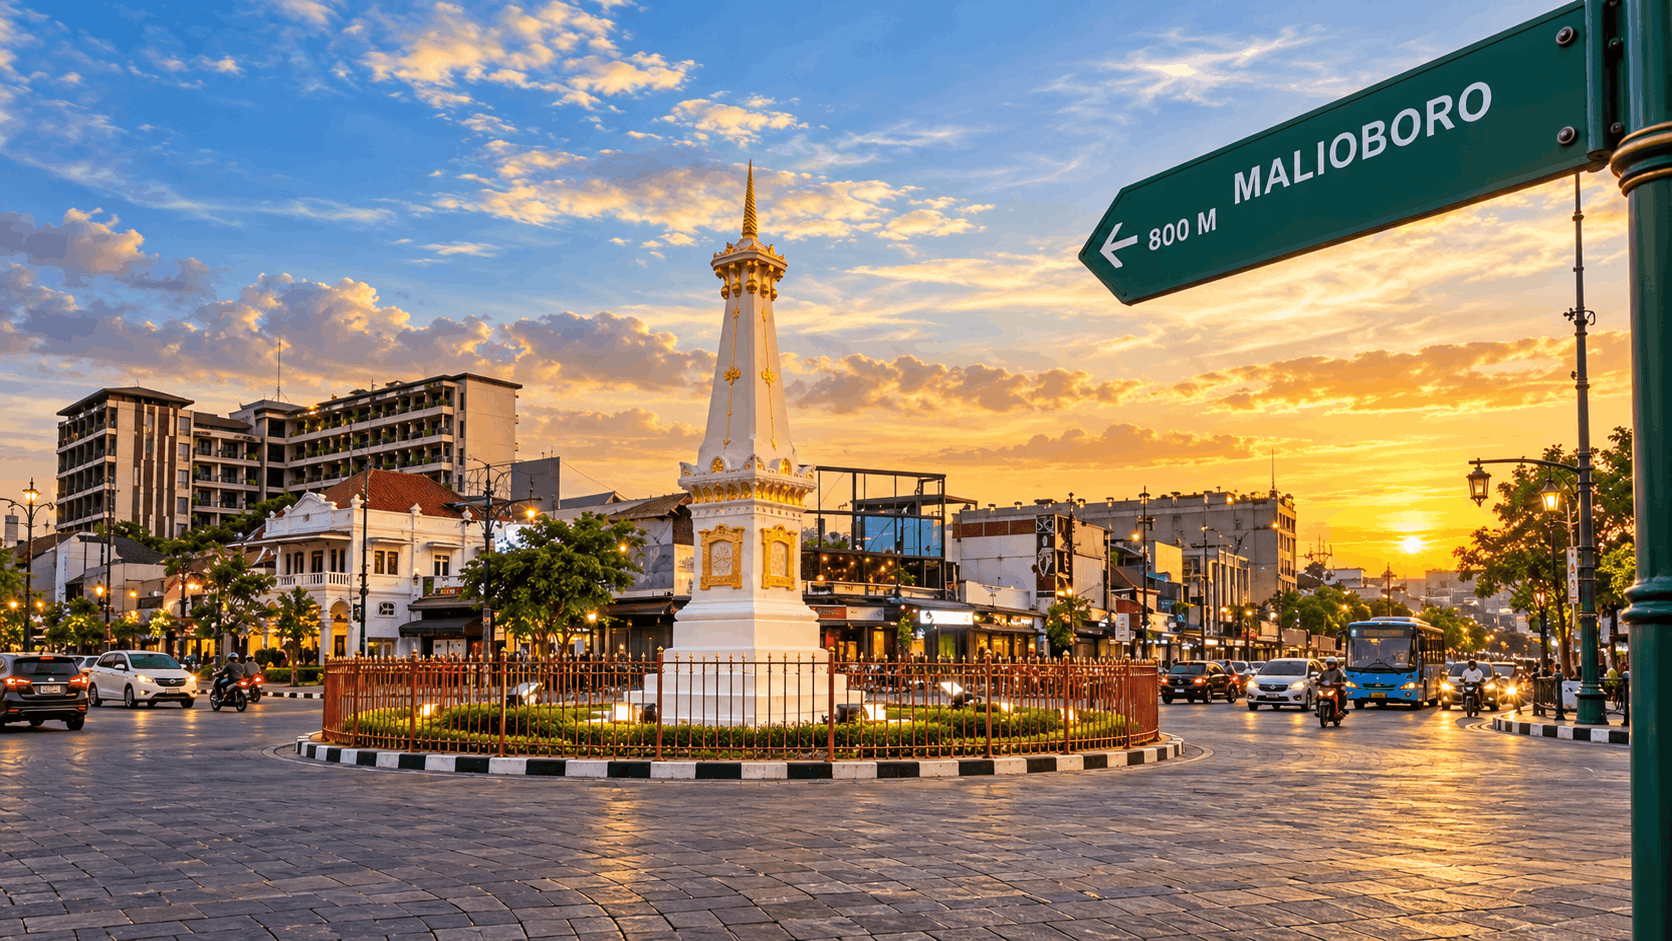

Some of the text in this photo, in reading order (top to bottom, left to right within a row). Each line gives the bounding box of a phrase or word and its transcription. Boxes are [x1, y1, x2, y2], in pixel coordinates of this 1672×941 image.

[1233, 81, 1493, 205] MALIOBORO
[1148, 207, 1217, 251] 800 M
